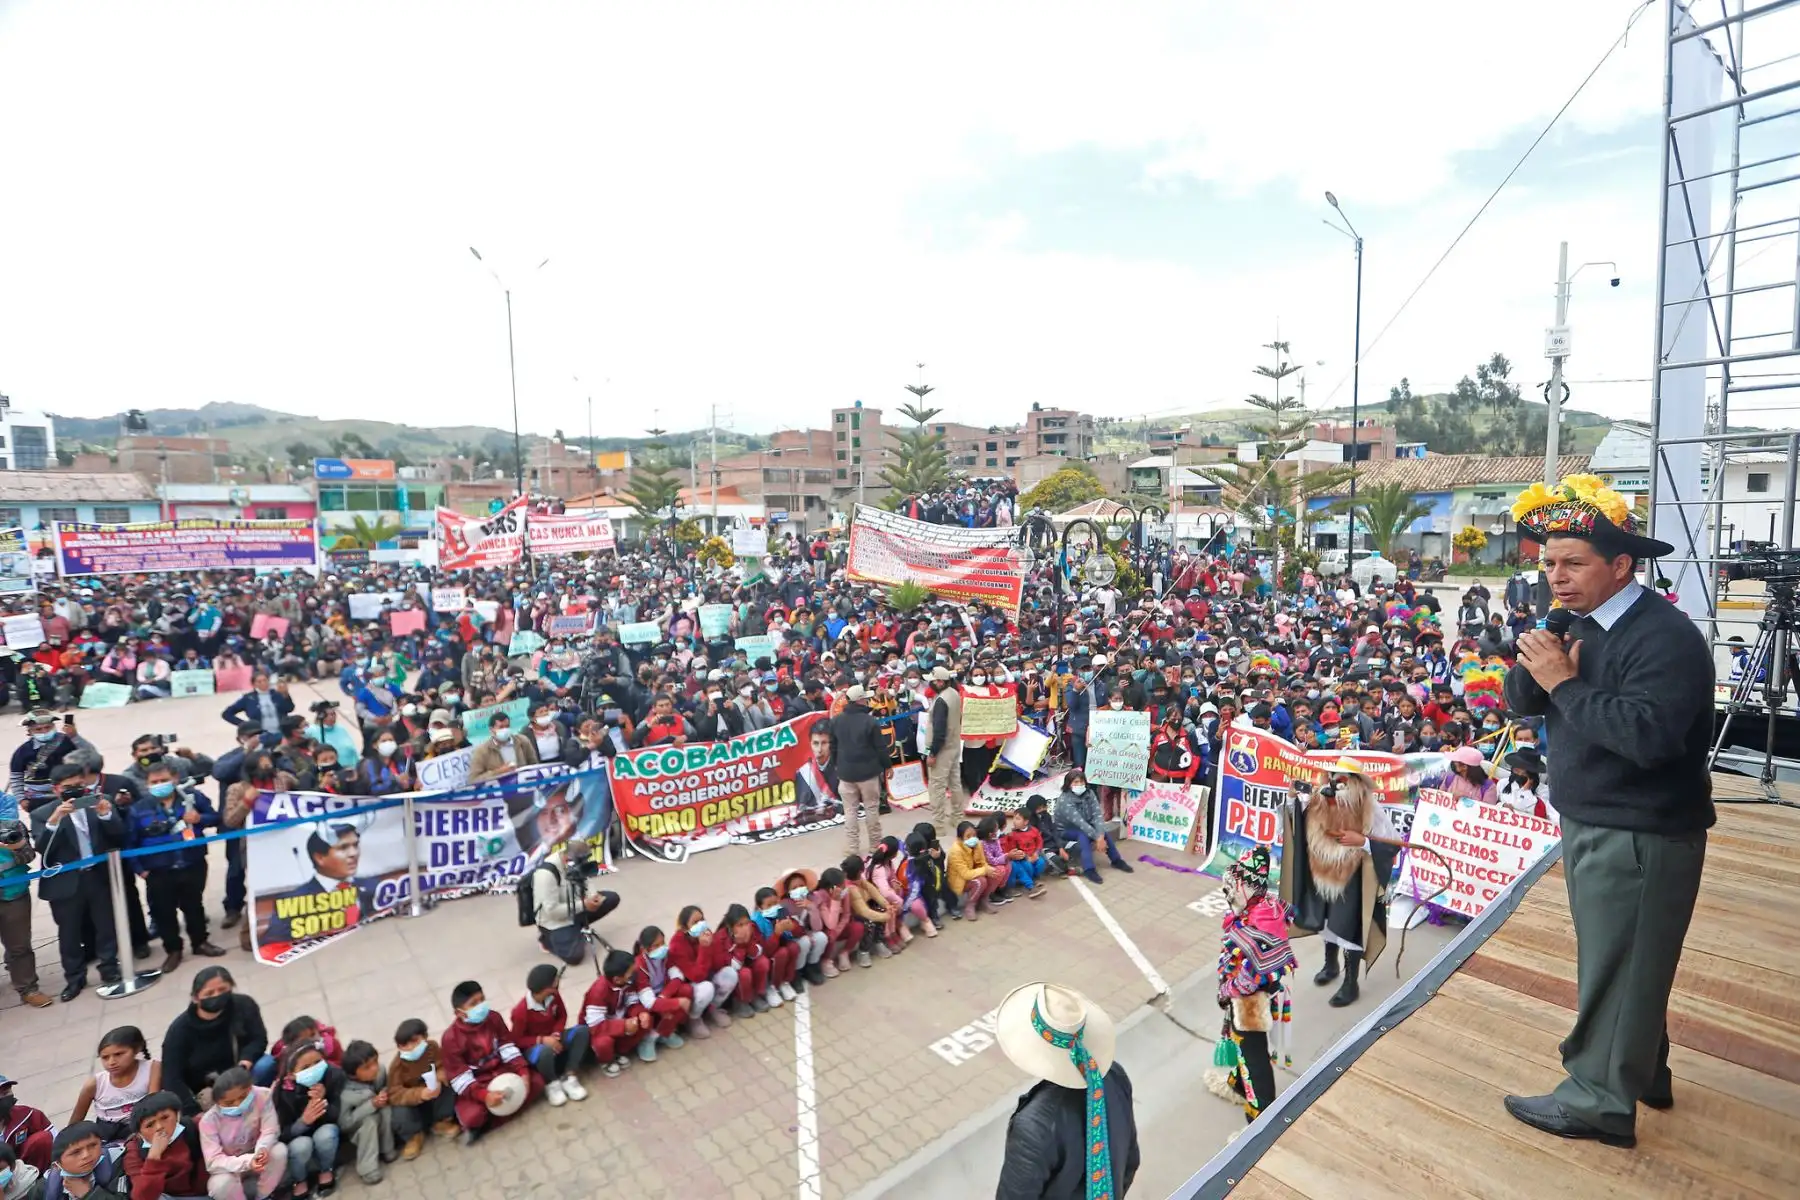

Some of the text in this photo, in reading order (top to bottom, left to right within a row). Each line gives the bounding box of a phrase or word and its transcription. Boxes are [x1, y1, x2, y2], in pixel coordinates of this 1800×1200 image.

[529, 528, 549, 541] CAS
[551, 525, 585, 539] NUNCA
[614, 724, 798, 780] ACOBAMBA
[634, 755, 781, 797] APOYO TOTAL AL
[1263, 756, 1312, 782] RAMÓN
[650, 771, 769, 811] GOBIERNO DE
[1420, 788, 1459, 811] SEÑOR
[404, 806, 504, 837] CIERRE
[626, 780, 797, 839] PEDRO CASTILLO
[1422, 830, 1499, 863] QUEREMOS
[1452, 820, 1533, 850] CASTILLO
[430, 840, 479, 867] DEL
[1410, 865, 1476, 897] NUESTRO
[275, 887, 358, 919] WILSON
[290, 910, 346, 938] SOTO
